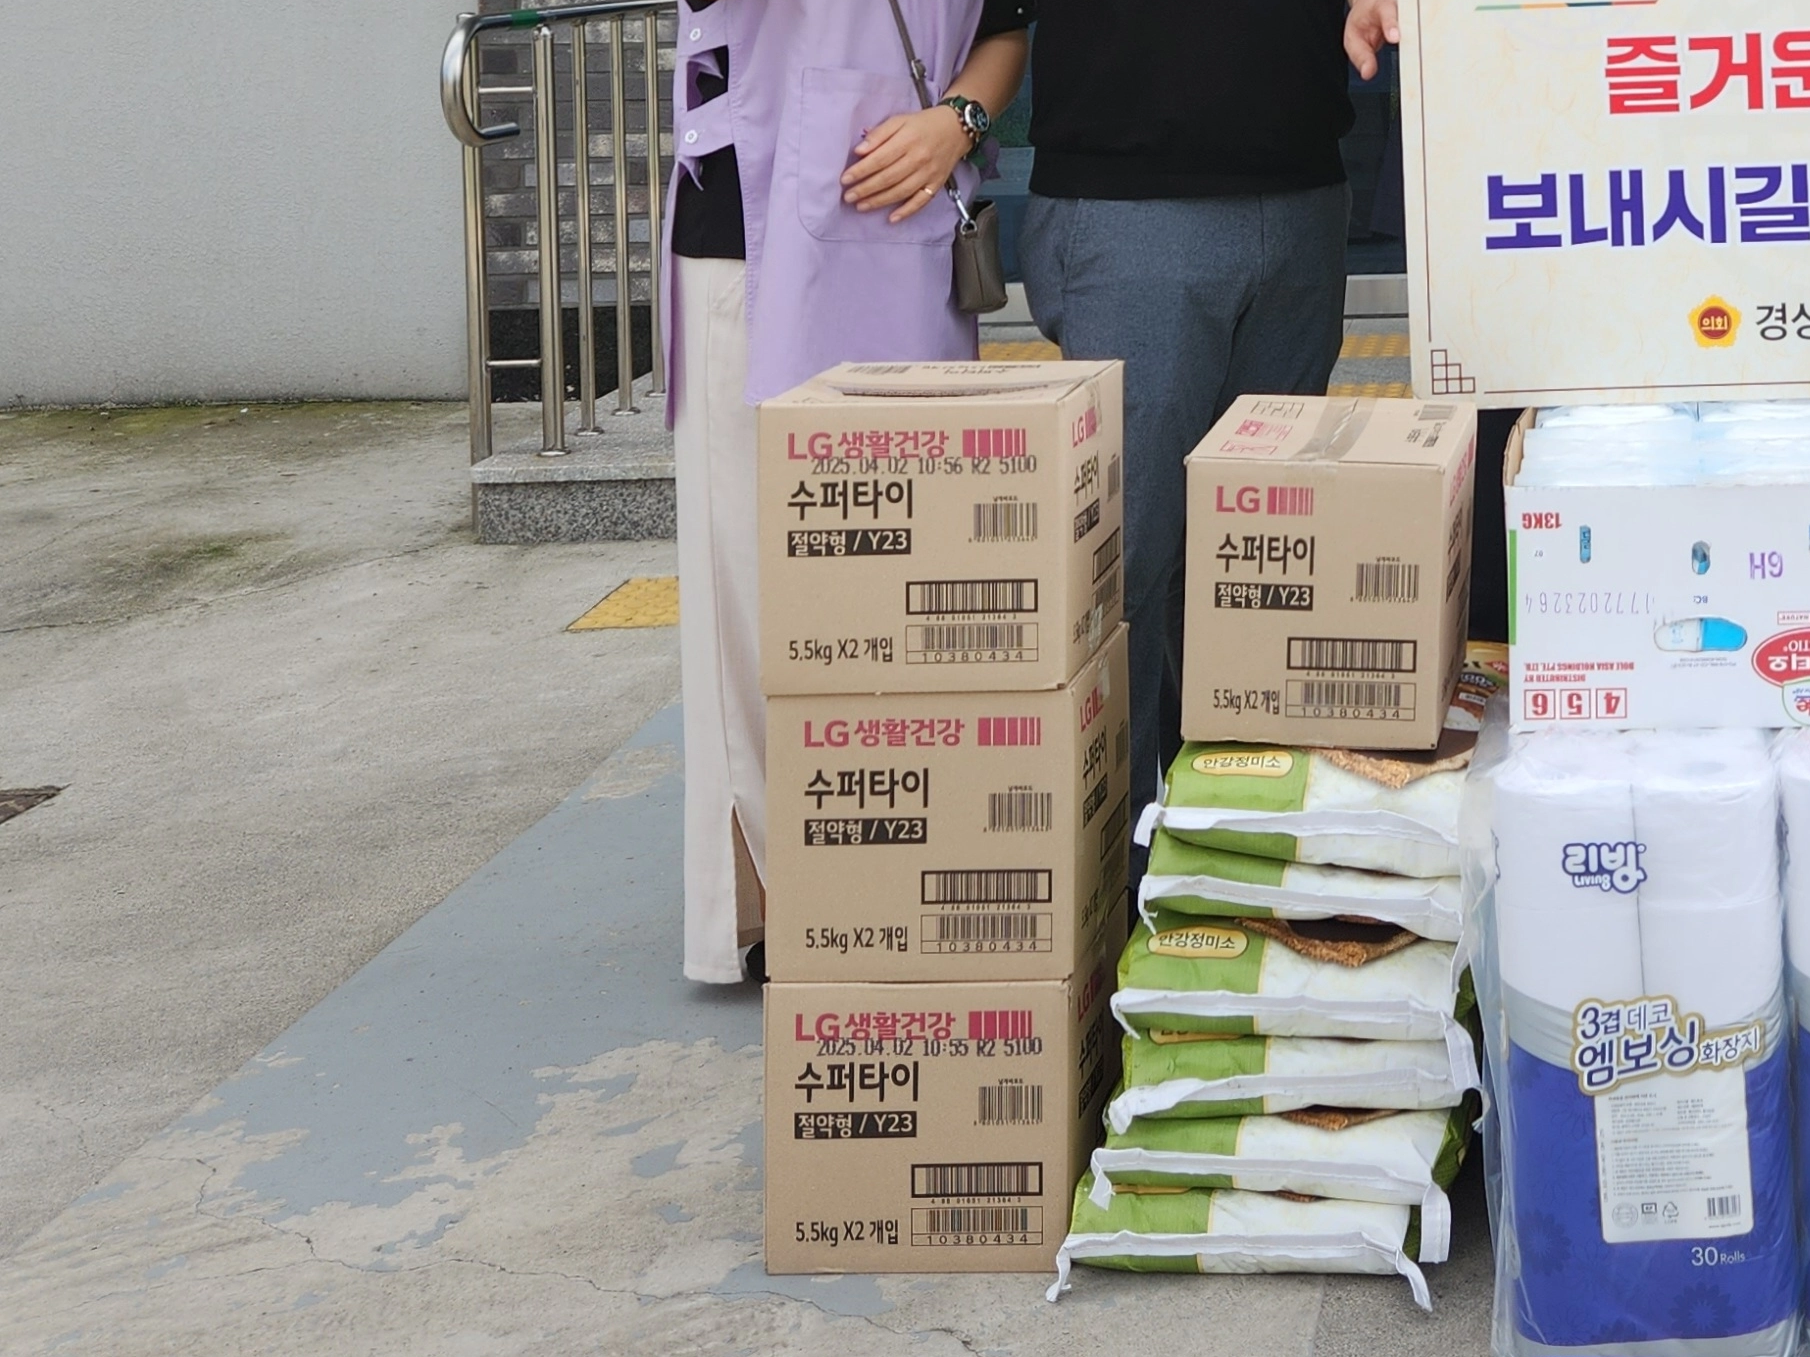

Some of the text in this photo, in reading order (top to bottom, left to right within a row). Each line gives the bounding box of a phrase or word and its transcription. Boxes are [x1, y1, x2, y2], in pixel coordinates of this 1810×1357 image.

[1701, 315, 1728, 331] 의회
[788, 430, 949, 460] LG 생활건강
[811, 457, 908, 474] 2025.04.02
[918, 457, 962, 474] 10:56
[1000, 455, 1036, 474] 5100
[787, 479, 913, 521] 수퍼타이
[1216, 485, 1260, 513] LG
[1521, 512, 1562, 530] 13KG
[791, 531, 846, 556] 절약형
[868, 530, 908, 550] Y23
[1216, 533, 1315, 576] 수퍼타이
[1749, 550, 1784, 580] 6H
[1218, 584, 1262, 609] 절약형
[1278, 586, 1311, 607] Y23
[789, 637, 893, 665] 5.5kg X2 개입
[922, 651, 1023, 663] 10380434
[1213, 689, 1281, 714] 5.5kg X2 개입
[1302, 708, 1400, 720] 10380434
[1532, 692, 1620, 716] 4 5 6
[804, 718, 965, 748] LG 생활건강
[1203, 755, 1280, 769] 안강정미소
[804, 768, 929, 810] 수퍼타이
[808, 820, 862, 845] 절약형
[883, 820, 923, 840] Y23
[1562, 841, 1647, 894] 리빙
[805, 926, 908, 953] 5.5kg X2 개입
[937, 941, 1037, 953] 10380434
[1159, 932, 1235, 950] 안강정미소
[796, 1011, 956, 1041] LG 생활건강
[1581, 1002, 1671, 1039] 3겹 데코
[817, 1037, 913, 1056] 2025.04.02
[923, 1037, 968, 1056] 10:55
[1003, 1036, 1042, 1056] 5100
[1578, 1020, 1758, 1087] 엠보싱 화장지
[794, 1061, 919, 1103] 수퍼타이
[798, 1114, 853, 1138] 절약형
[873, 1113, 913, 1133] Y23
[795, 1219, 899, 1247] 5.5kg X2 개입
[927, 1234, 1028, 1245] 10380434
[1691, 1246, 1746, 1266] 30 Rolls
